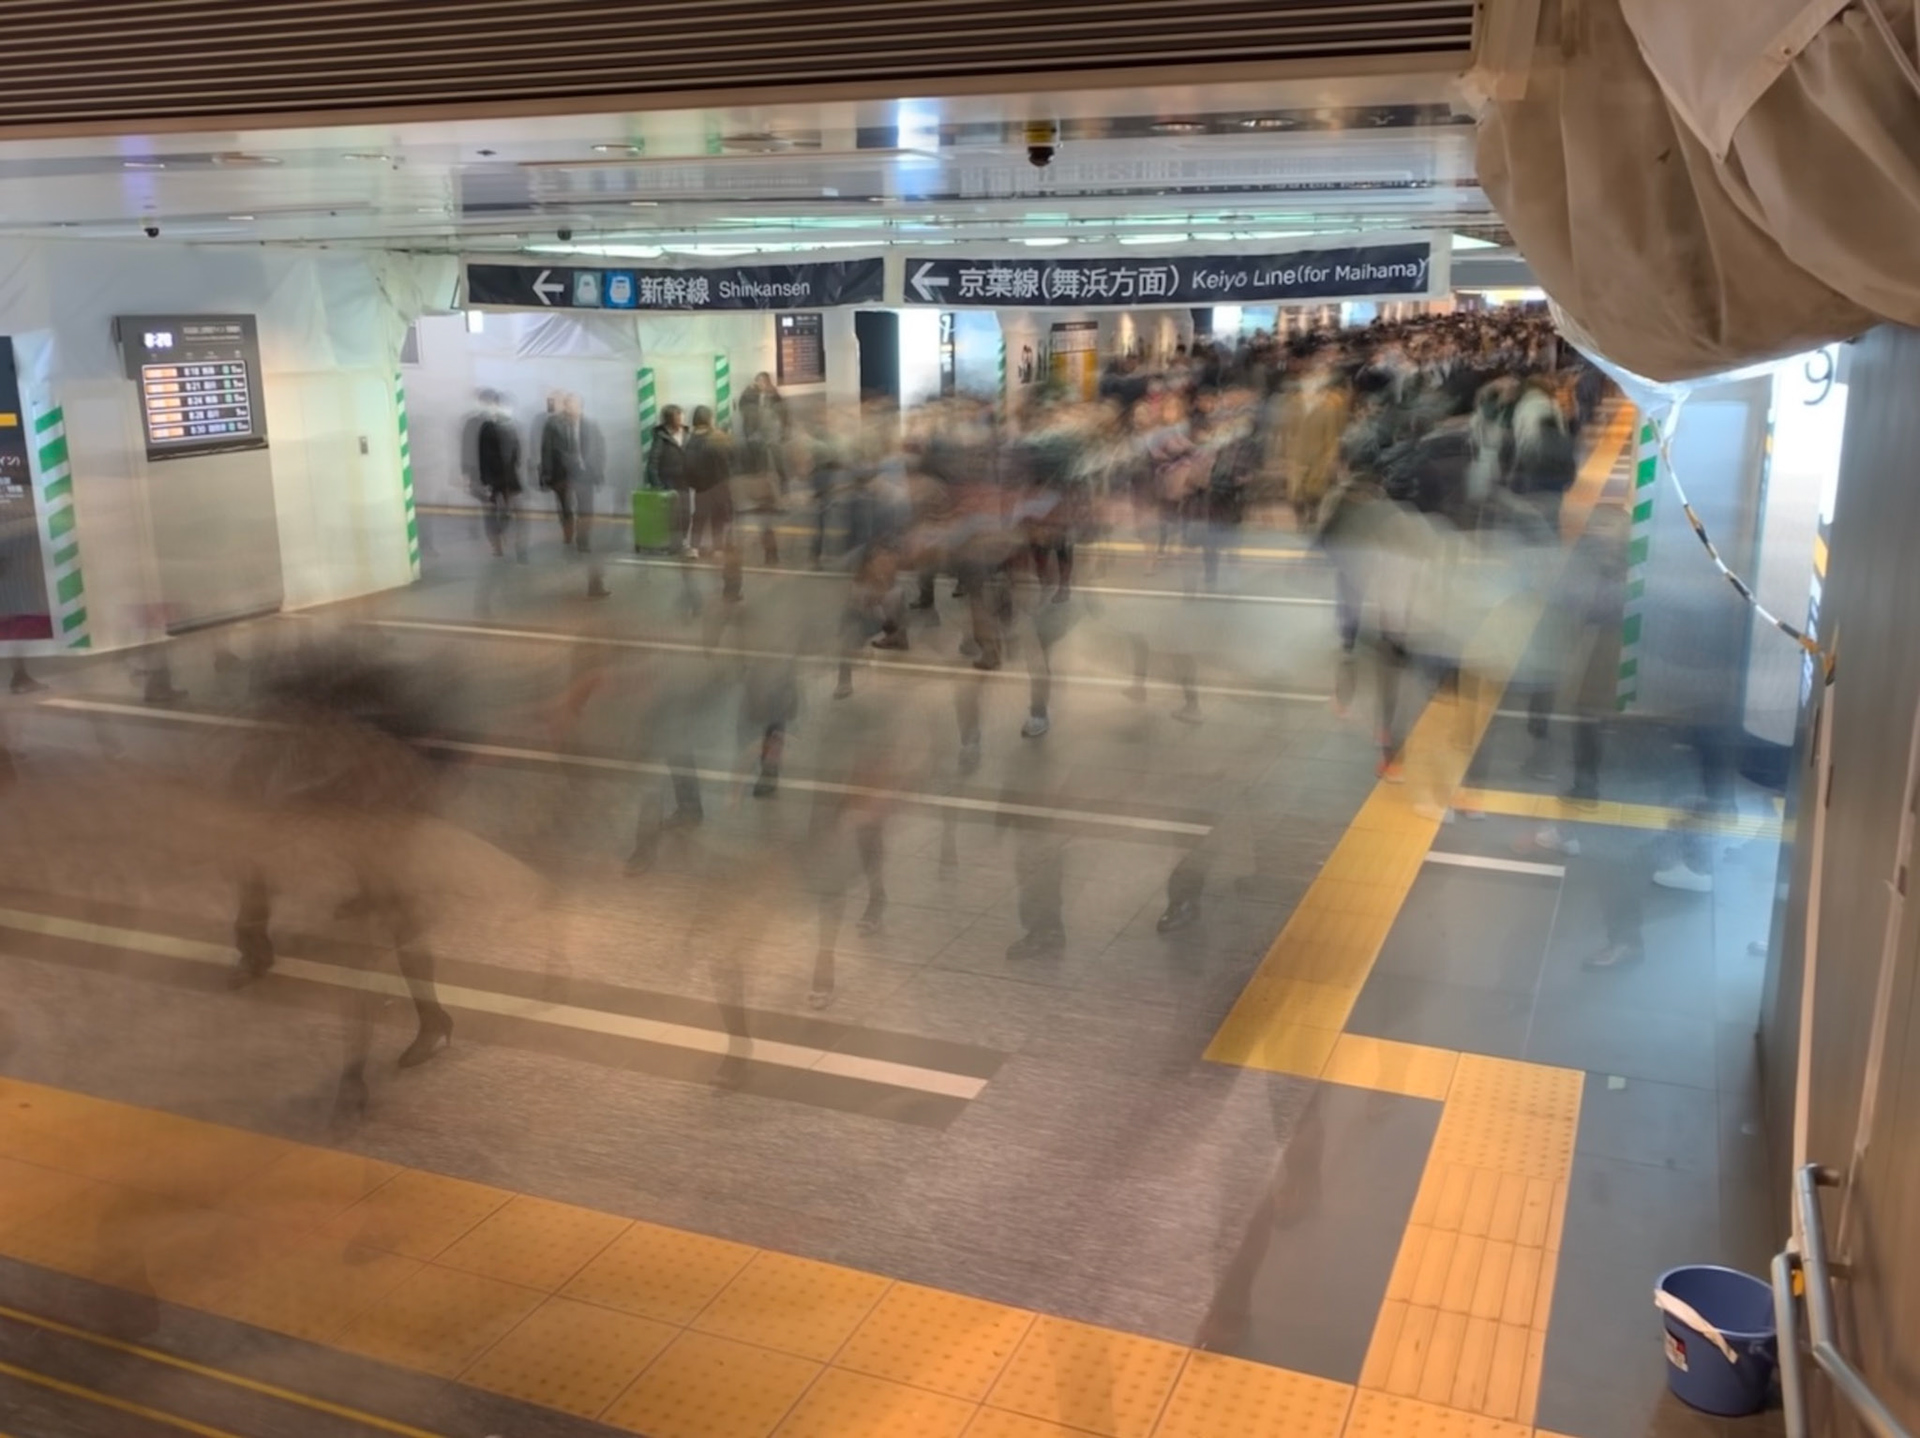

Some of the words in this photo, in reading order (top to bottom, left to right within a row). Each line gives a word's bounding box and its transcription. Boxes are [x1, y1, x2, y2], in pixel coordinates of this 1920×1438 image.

[1335, 259, 1427, 281] Maihama)
[640, 276, 710, 305] 新幹線
[719, 281, 811, 298] Shinkansen
[1803, 348, 1833, 405] 9
